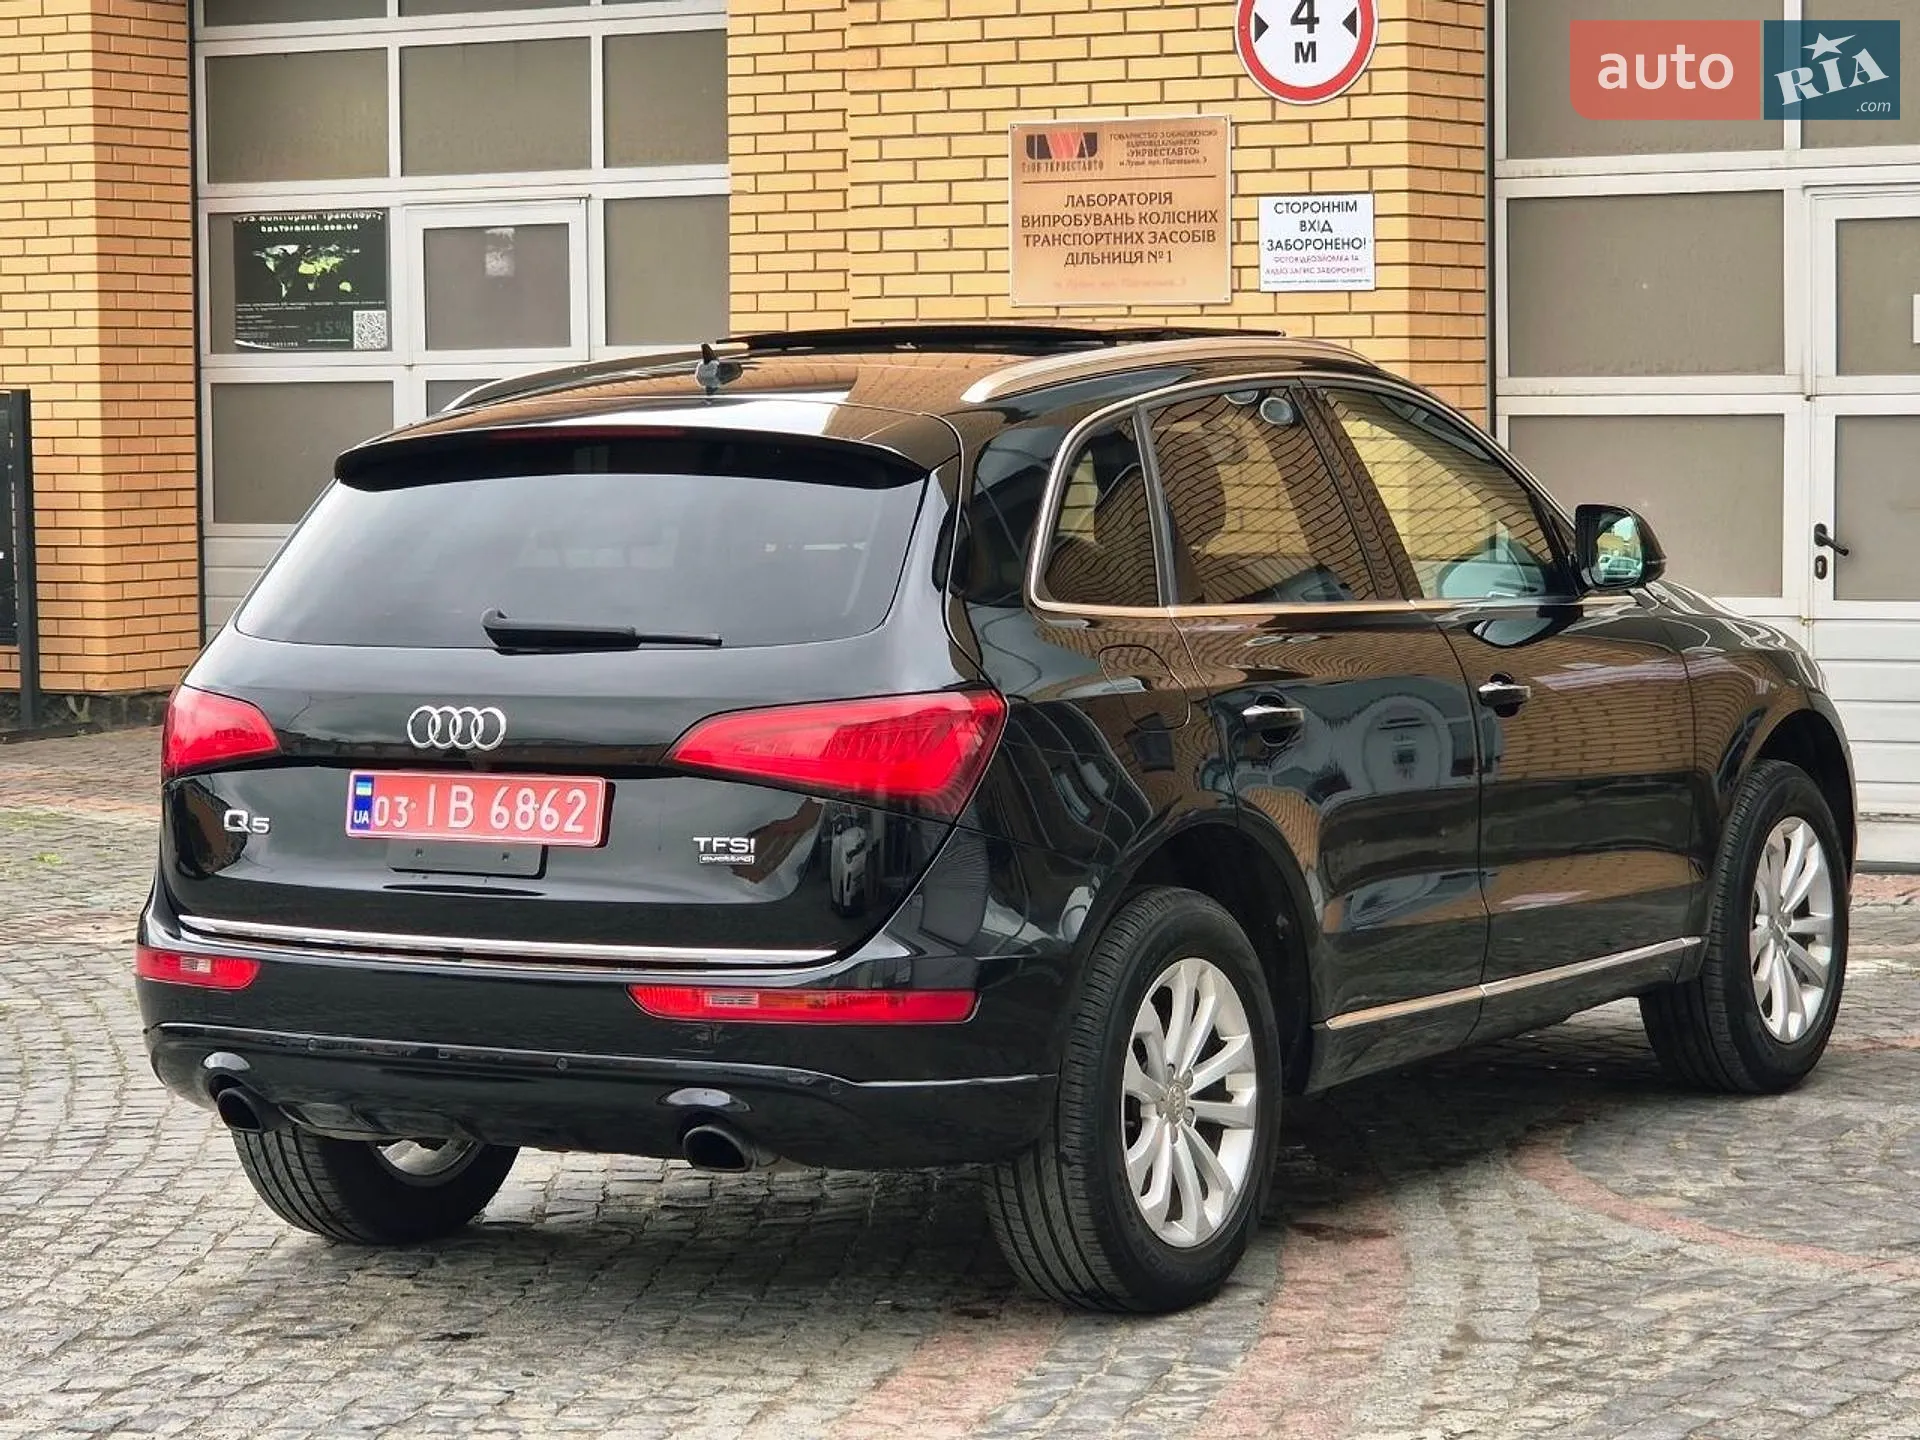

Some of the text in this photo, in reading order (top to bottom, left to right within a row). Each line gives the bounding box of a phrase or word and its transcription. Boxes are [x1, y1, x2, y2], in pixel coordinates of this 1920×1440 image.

[1290, 0, 1320, 34] 4
[1064, 192, 1173, 208] ЛАБОРАТОРІЯ
[1274, 200, 1358, 214] СТОРОННІМ
[1021, 210, 1218, 228] ВИПРОБУВАНЬ КОЛІСНИХ
[1299, 219, 1333, 233] ВХІД
[1024, 229, 1217, 248] ТРАНСПОРТНИХ ЗАСОБІВ
[1267, 237, 1367, 251] ЗАБОРОНЕНО!
[1064, 251, 1144, 268] ДІЛЬНИЦЯ
[353, 810, 370, 825] UA
[374, 796, 409, 828] 03
[490, 786, 588, 833] 6862
[693, 837, 756, 854] TFSI
